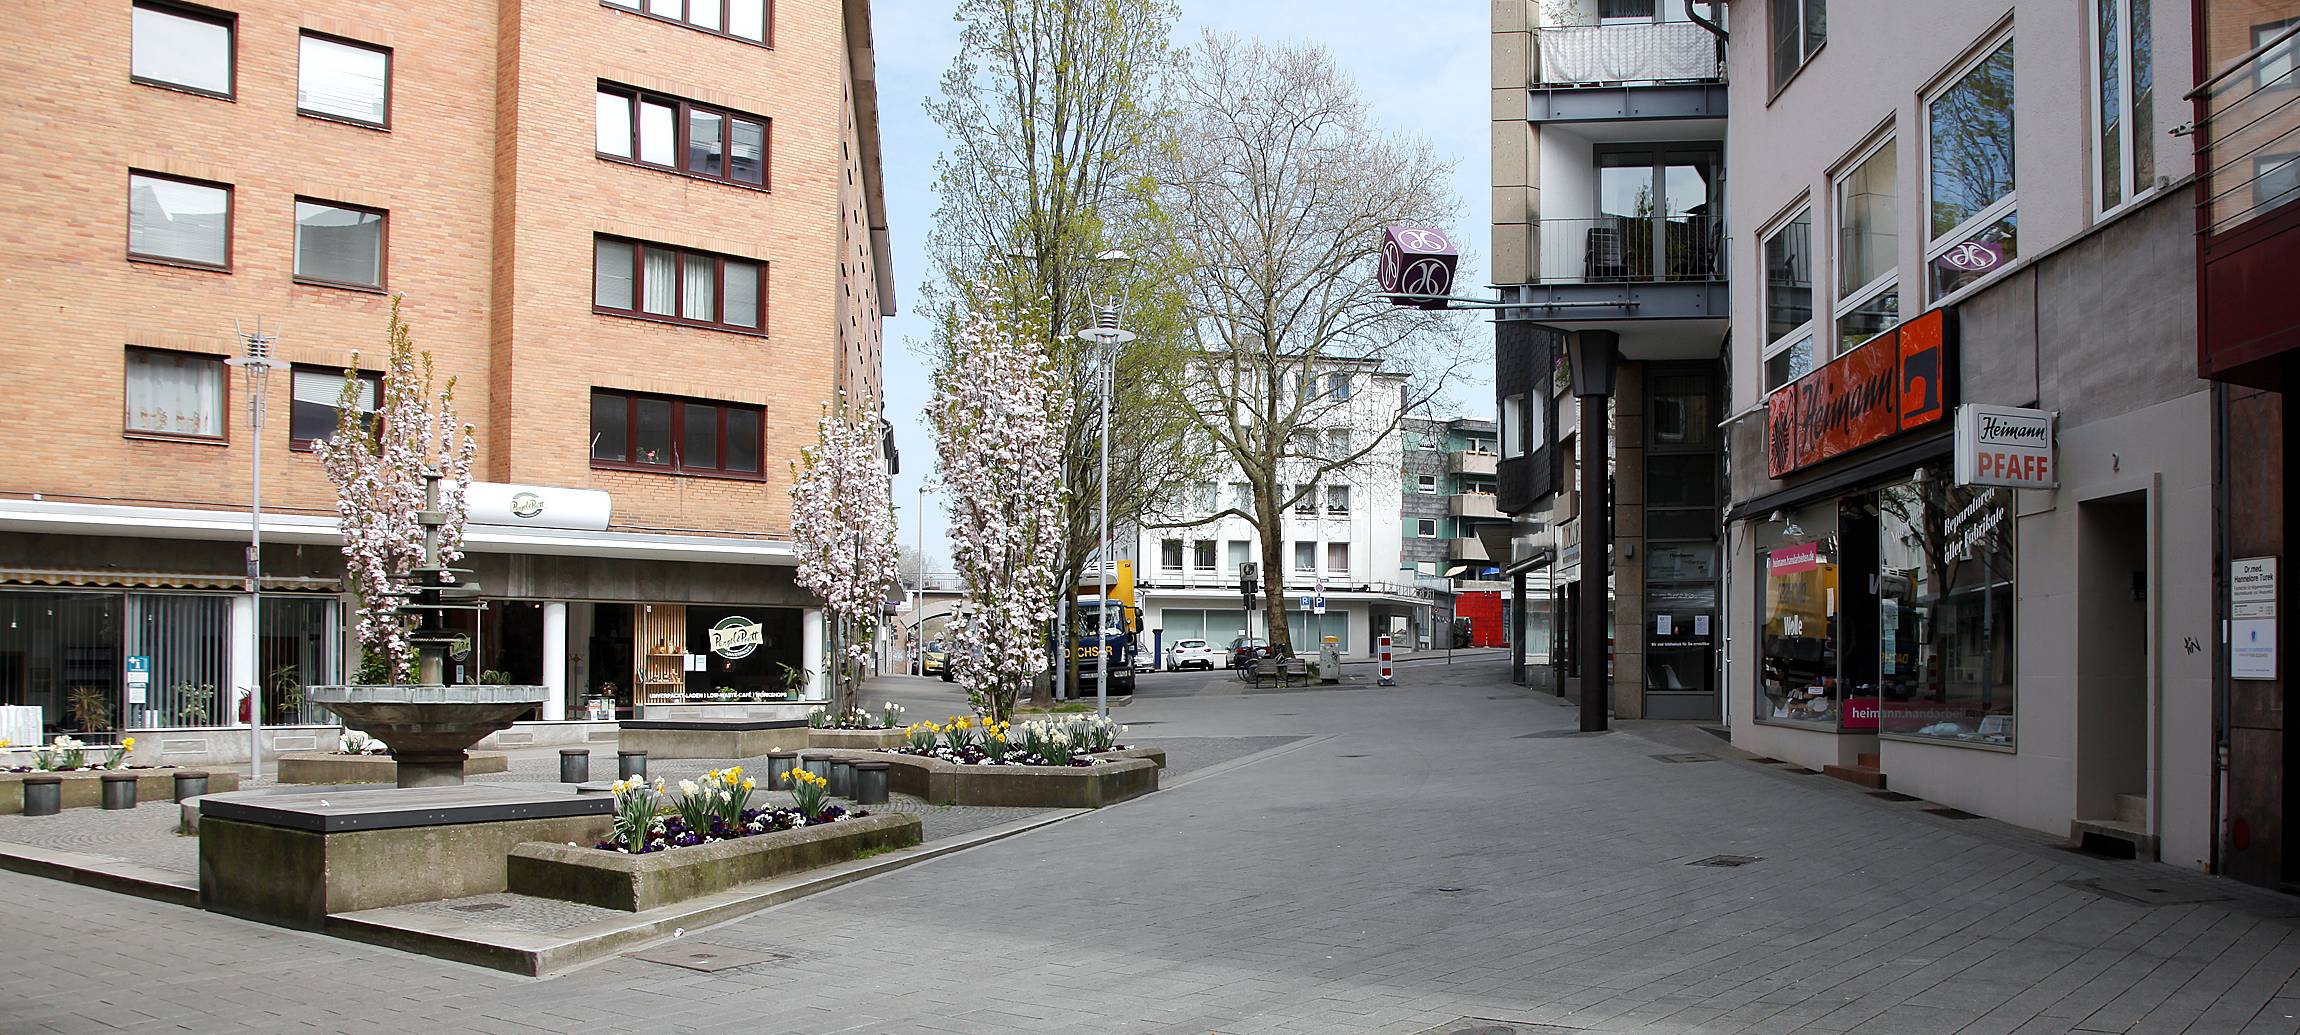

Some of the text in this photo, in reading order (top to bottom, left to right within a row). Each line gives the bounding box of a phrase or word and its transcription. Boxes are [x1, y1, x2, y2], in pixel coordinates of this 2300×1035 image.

[1802, 366, 1894, 442] Heimann
[1980, 416, 2046, 441] Heimann
[1978, 452, 2048, 481] PFAFF
[2112, 453, 2120, 472] 2
[1944, 539, 1963, 566] aller
[1964, 506, 2005, 548] Fabrikate
[2234, 573, 2274, 583] Hannelore Turek
[1316, 598, 1322, 608] P
[1783, 615, 1803, 635] Wolle
[1064, 646, 1113, 658] DCHSR
